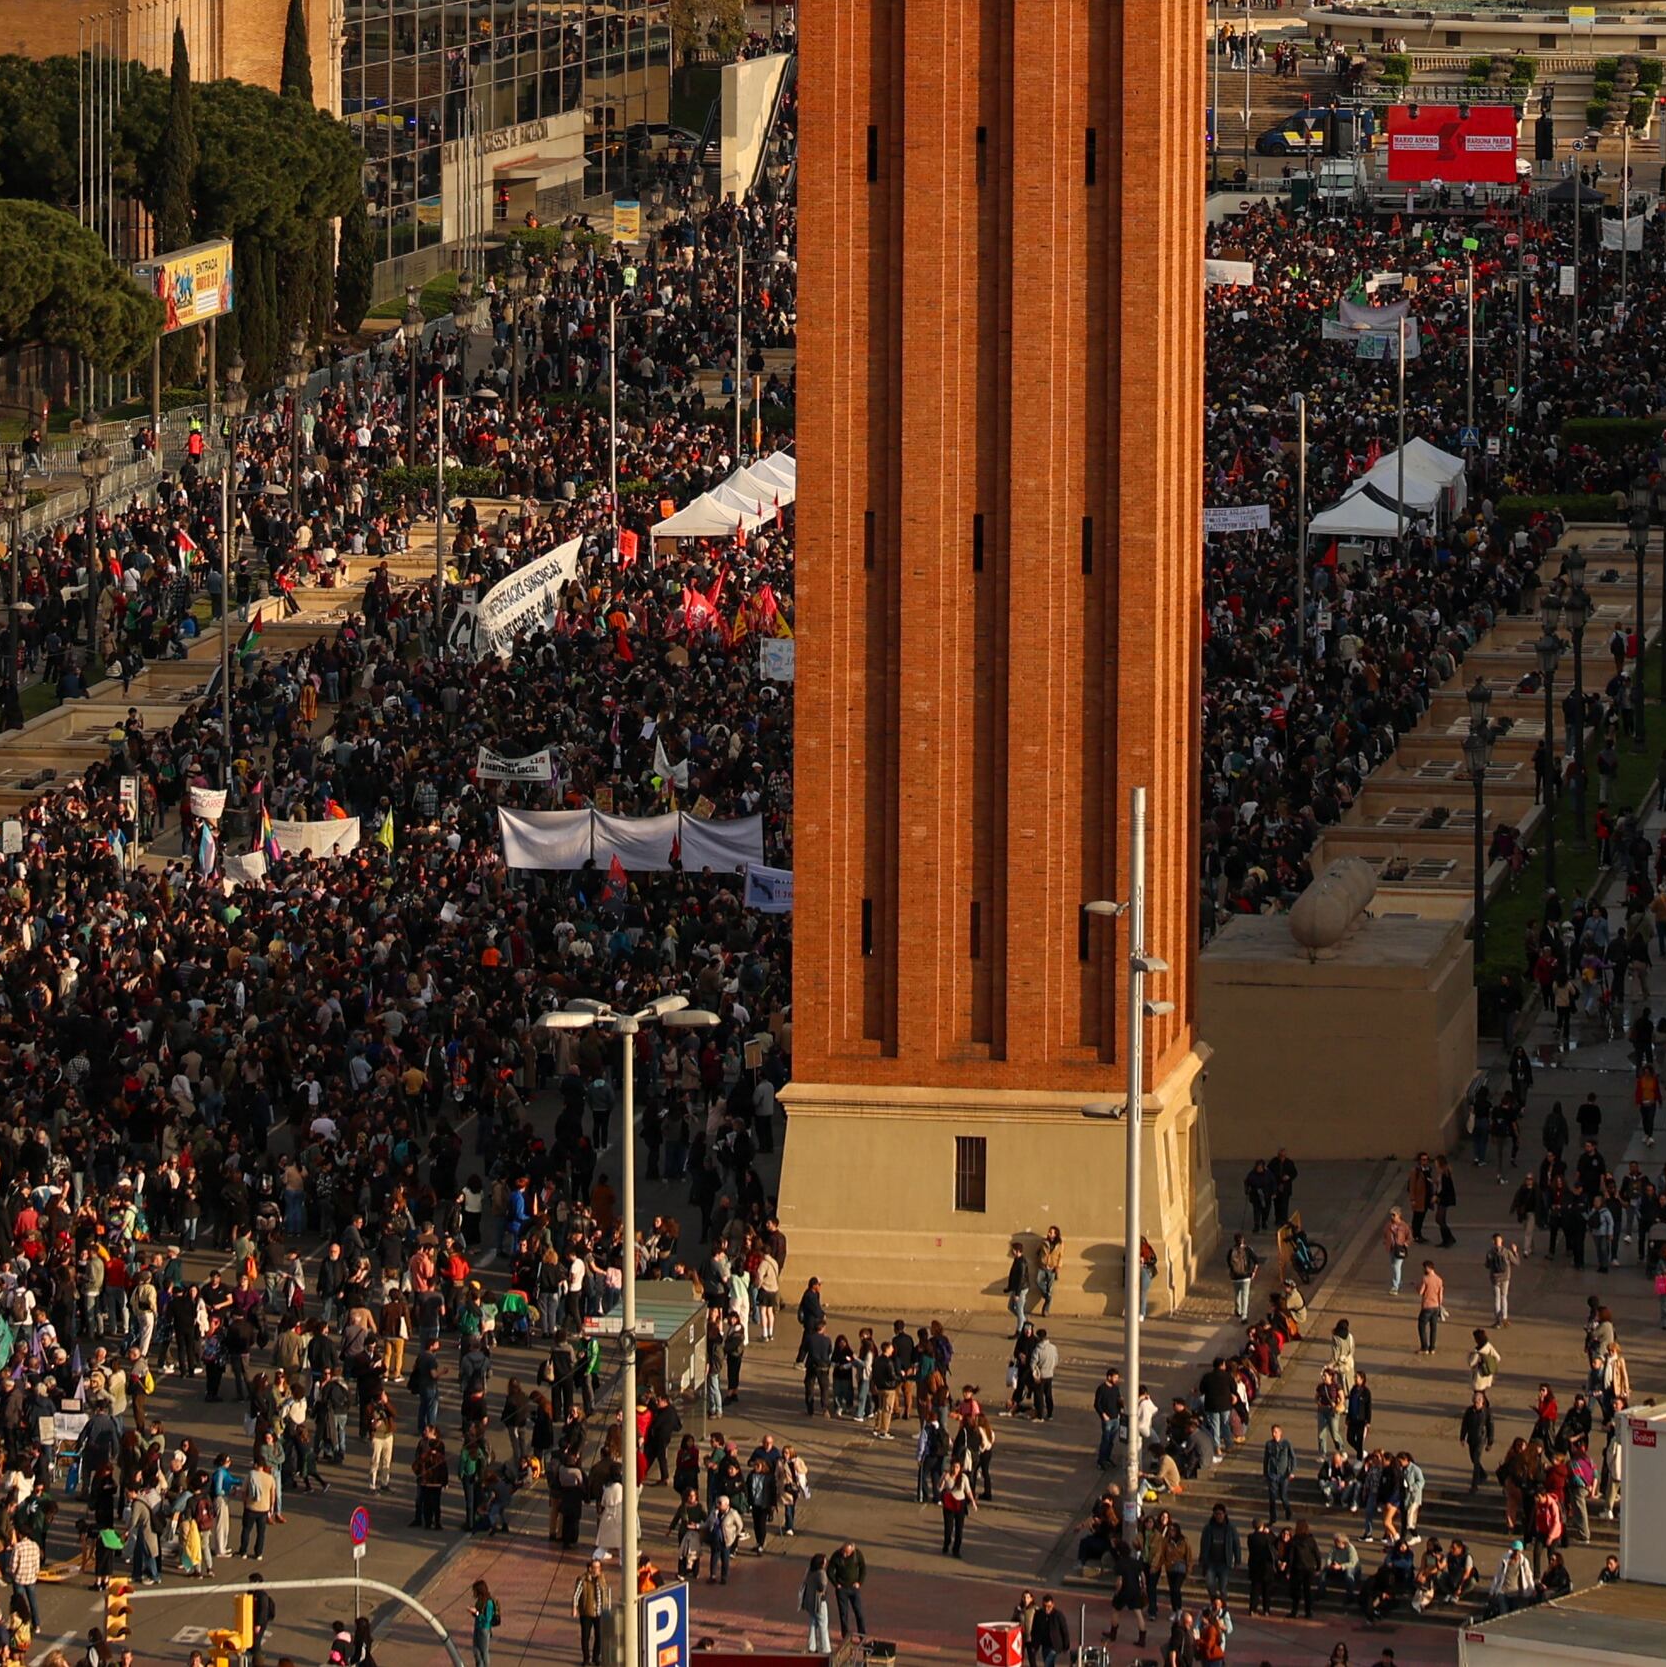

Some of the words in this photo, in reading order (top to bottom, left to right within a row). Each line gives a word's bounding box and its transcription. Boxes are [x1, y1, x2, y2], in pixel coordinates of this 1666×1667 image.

[195, 257, 218, 275] ENTRADA
[517, 765, 539, 774] SOCIAL
[648, 1596, 678, 1667] P
[983, 1637, 993, 1652] M
